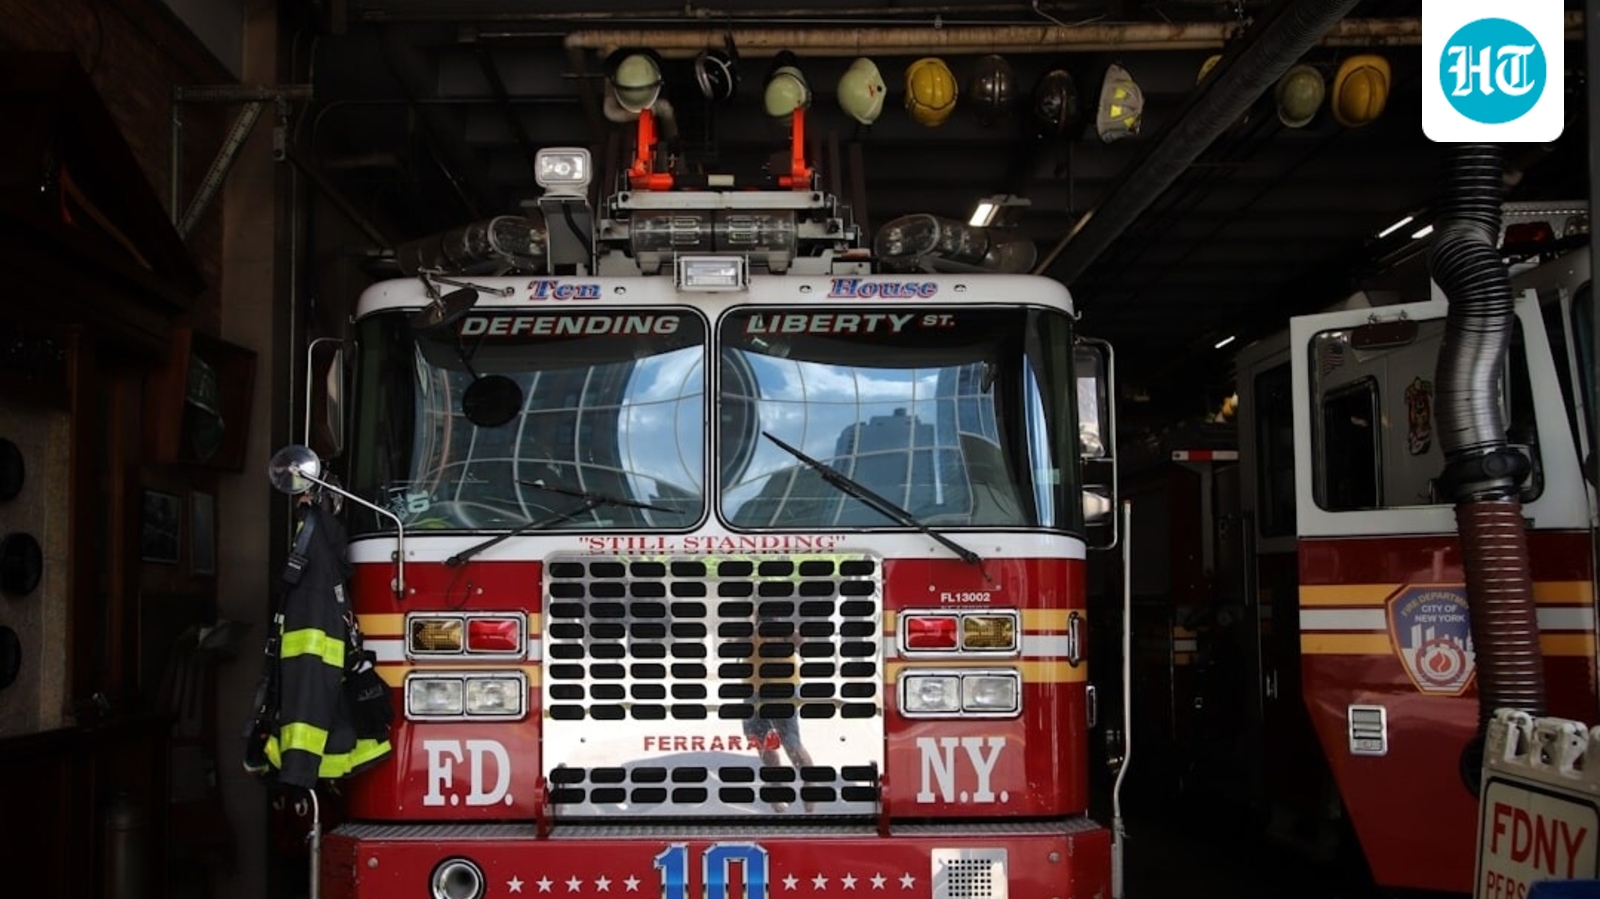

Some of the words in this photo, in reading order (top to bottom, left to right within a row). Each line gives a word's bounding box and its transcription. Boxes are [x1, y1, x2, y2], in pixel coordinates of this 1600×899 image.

[528, 279, 602, 300] Ten
[828, 278, 938, 299] House
[460, 315, 681, 336] DEFENDING
[746, 313, 914, 334] LIBERTY
[922, 313, 955, 327] ST.
[579, 535, 675, 550] "STILL
[683, 535, 847, 550] STANDING"
[940, 592, 991, 603] FL13002
[1400, 598, 1419, 617] FIRE
[1414, 613, 1437, 622] NEW
[1438, 613, 1466, 623] YORK
[1421, 604, 1443, 613] CITY
[1444, 604, 1457, 613] OF
[643, 735, 763, 751] FERRARA
[423, 739, 513, 807] F.D.
[916, 736, 1009, 804] N.Y.
[1491, 801, 1588, 881] FDNY
[653, 842, 770, 899] 10
